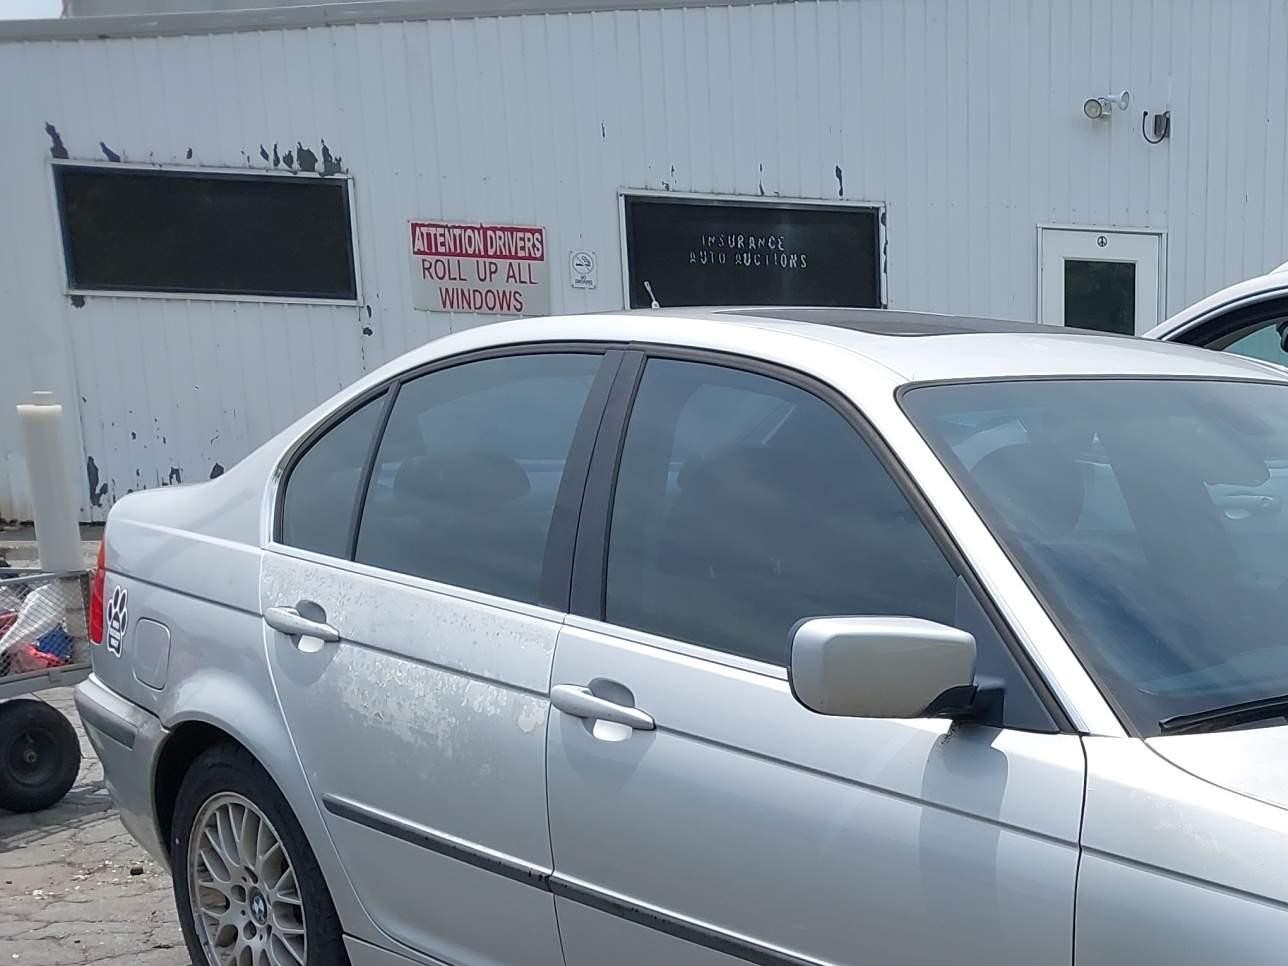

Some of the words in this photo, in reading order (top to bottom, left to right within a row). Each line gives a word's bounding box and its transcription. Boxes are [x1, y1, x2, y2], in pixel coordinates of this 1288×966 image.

[414, 226, 485, 256] ATTENTION
[487, 229, 543, 258] DRIVERS
[702, 233, 785, 251] INSURANCE
[422, 258, 468, 282] ROLL
[476, 261, 498, 283] UP
[506, 262, 538, 285] ALL
[689, 251, 726, 265] AUTO
[735, 251, 808, 268] AUCTIONS
[439, 287, 524, 312] WINDOWS
